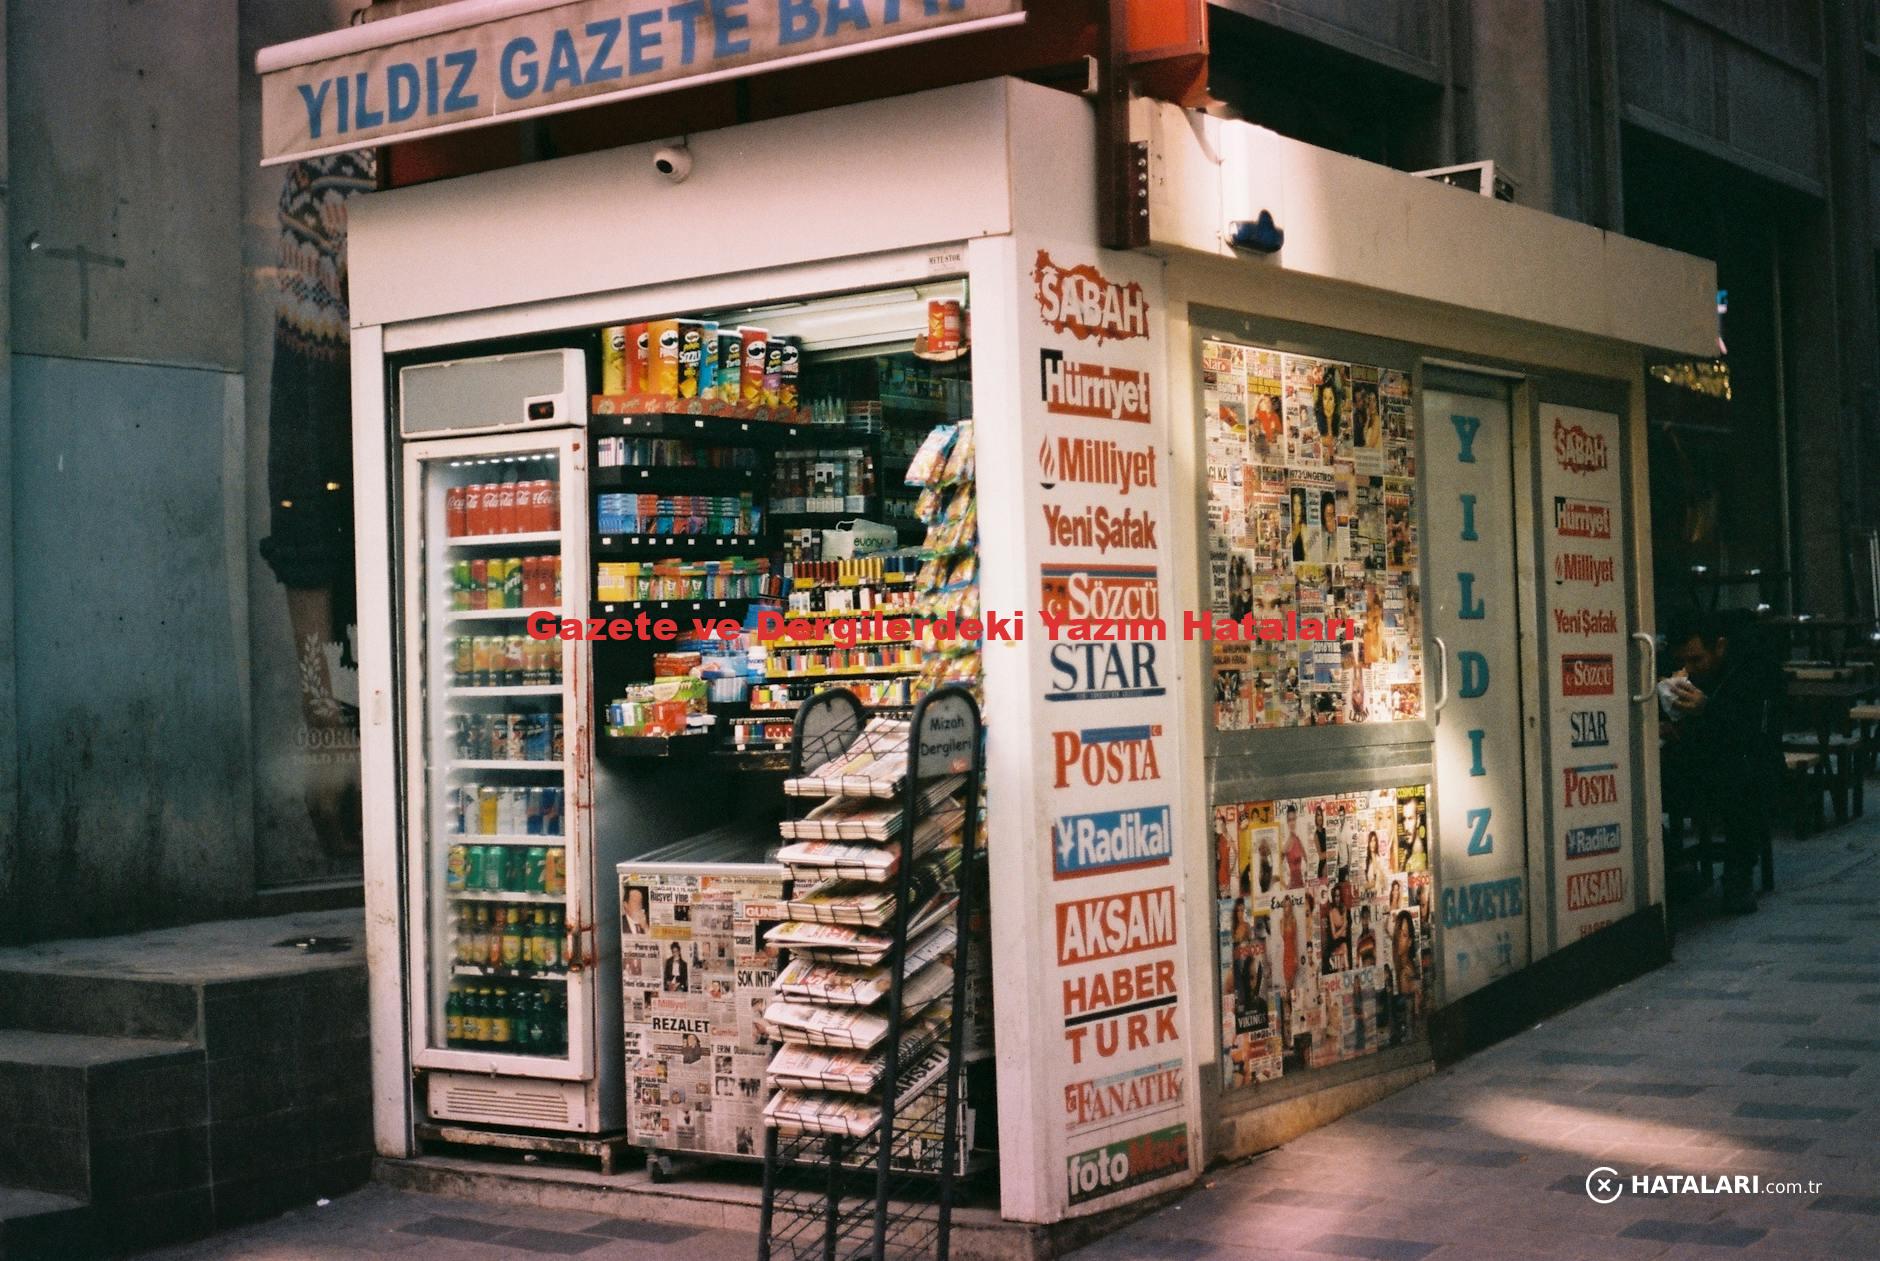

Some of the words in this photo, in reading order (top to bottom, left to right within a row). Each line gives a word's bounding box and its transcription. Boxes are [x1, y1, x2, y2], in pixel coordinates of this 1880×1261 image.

[298, 51, 479, 139] YILDIZ
[500, 1, 753, 100] GAZETE
[1041, 268, 1145, 335] SABAH
[1045, 357, 1149, 419] Hürriyet
[1057, 436, 1157, 495] Milliyet
[1564, 552, 1614, 587] Milliyet
[1050, 642, 1159, 691] STAR
[921, 738, 971, 757] Dergileri
[930, 715, 965, 731] Mizah
[1570, 710, 1608, 741] STAR
[1052, 731, 1161, 789] POSTA
[1077, 809, 1171, 866] Radikal
[1577, 824, 1619, 853] Radikal
[1063, 960, 1175, 1015] HABER
[652, 1017, 710, 1033] REZALET
[1065, 1006, 1179, 1064] TURK
